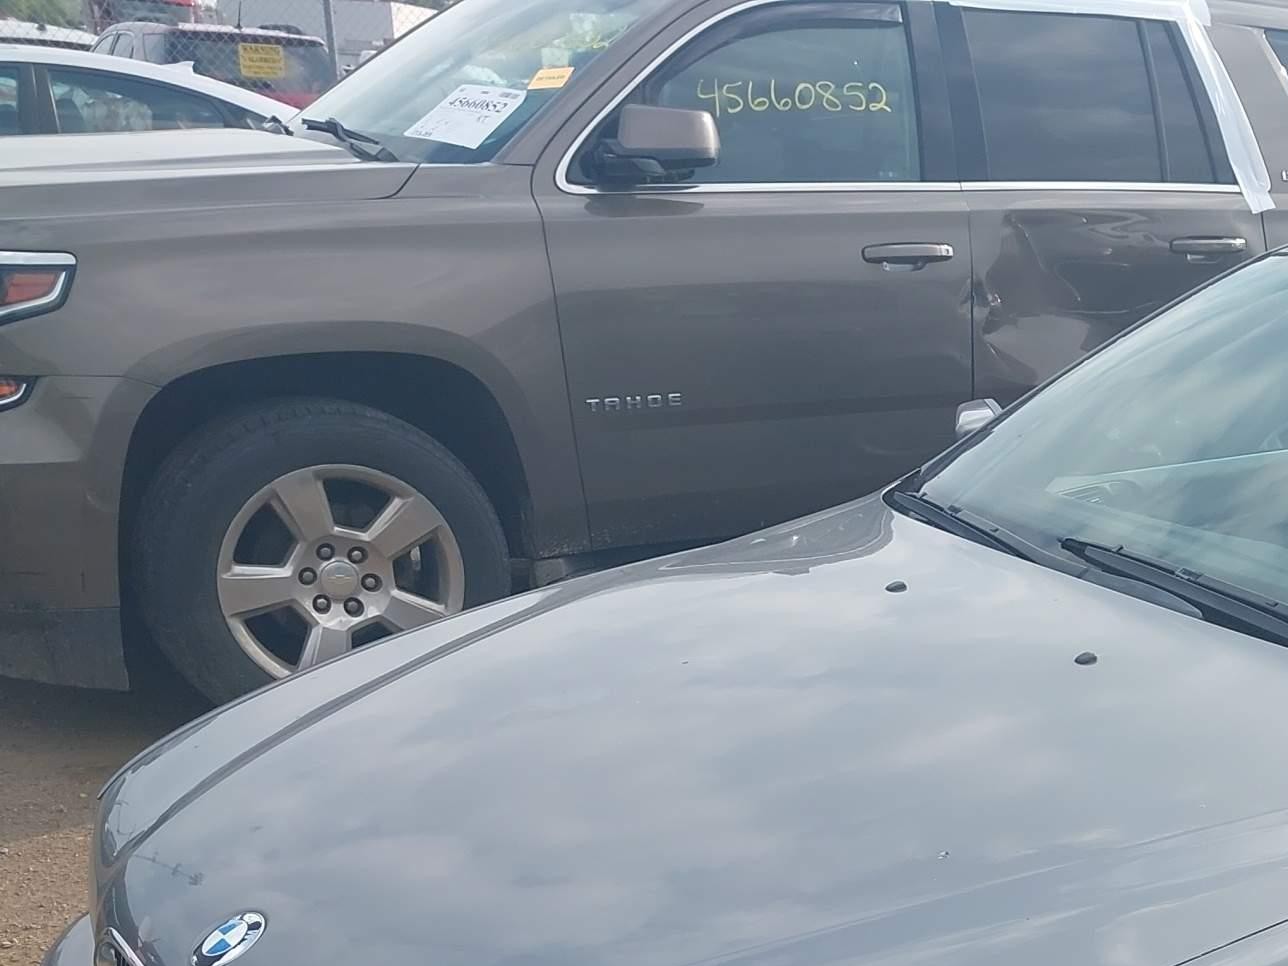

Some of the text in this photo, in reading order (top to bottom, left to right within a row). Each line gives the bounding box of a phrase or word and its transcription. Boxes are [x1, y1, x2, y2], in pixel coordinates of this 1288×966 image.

[448, 96, 509, 113] 45660852
[696, 78, 893, 118] 45660852
[585, 393, 682, 412] TAHOE
